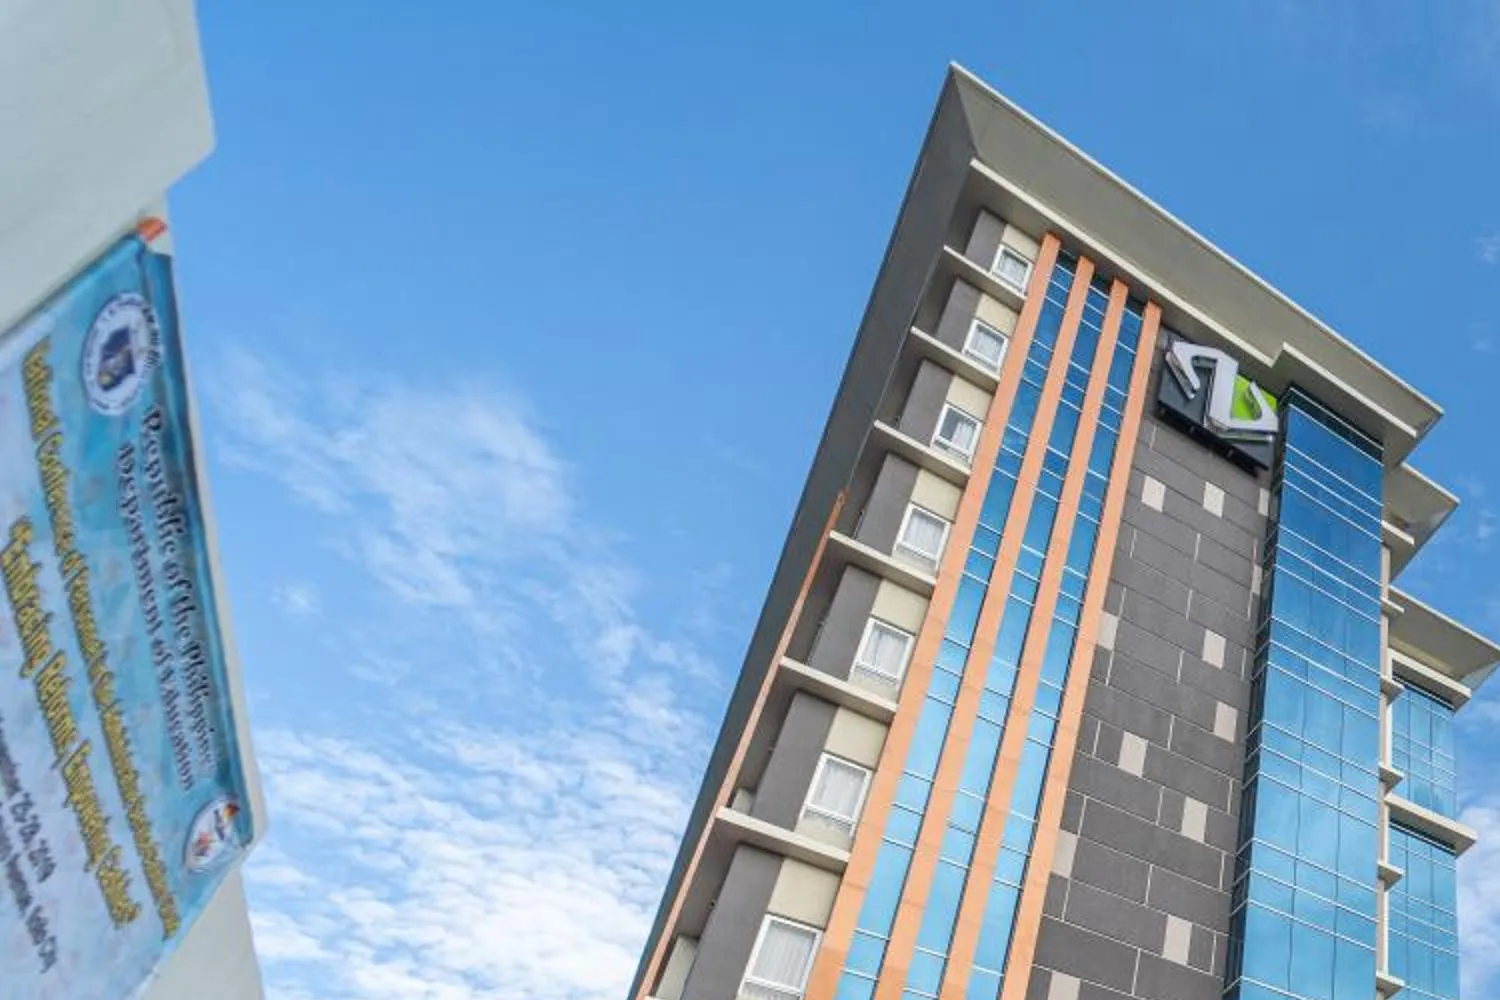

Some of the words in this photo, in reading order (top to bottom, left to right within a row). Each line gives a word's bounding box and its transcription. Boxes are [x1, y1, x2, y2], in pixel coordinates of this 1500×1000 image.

[142, 406, 184, 554] Republic
[117, 440, 165, 636] Department
[163, 555, 193, 589] of
[153, 636, 173, 667] of
[171, 592, 197, 639] the
[159, 666, 194, 791] Education
